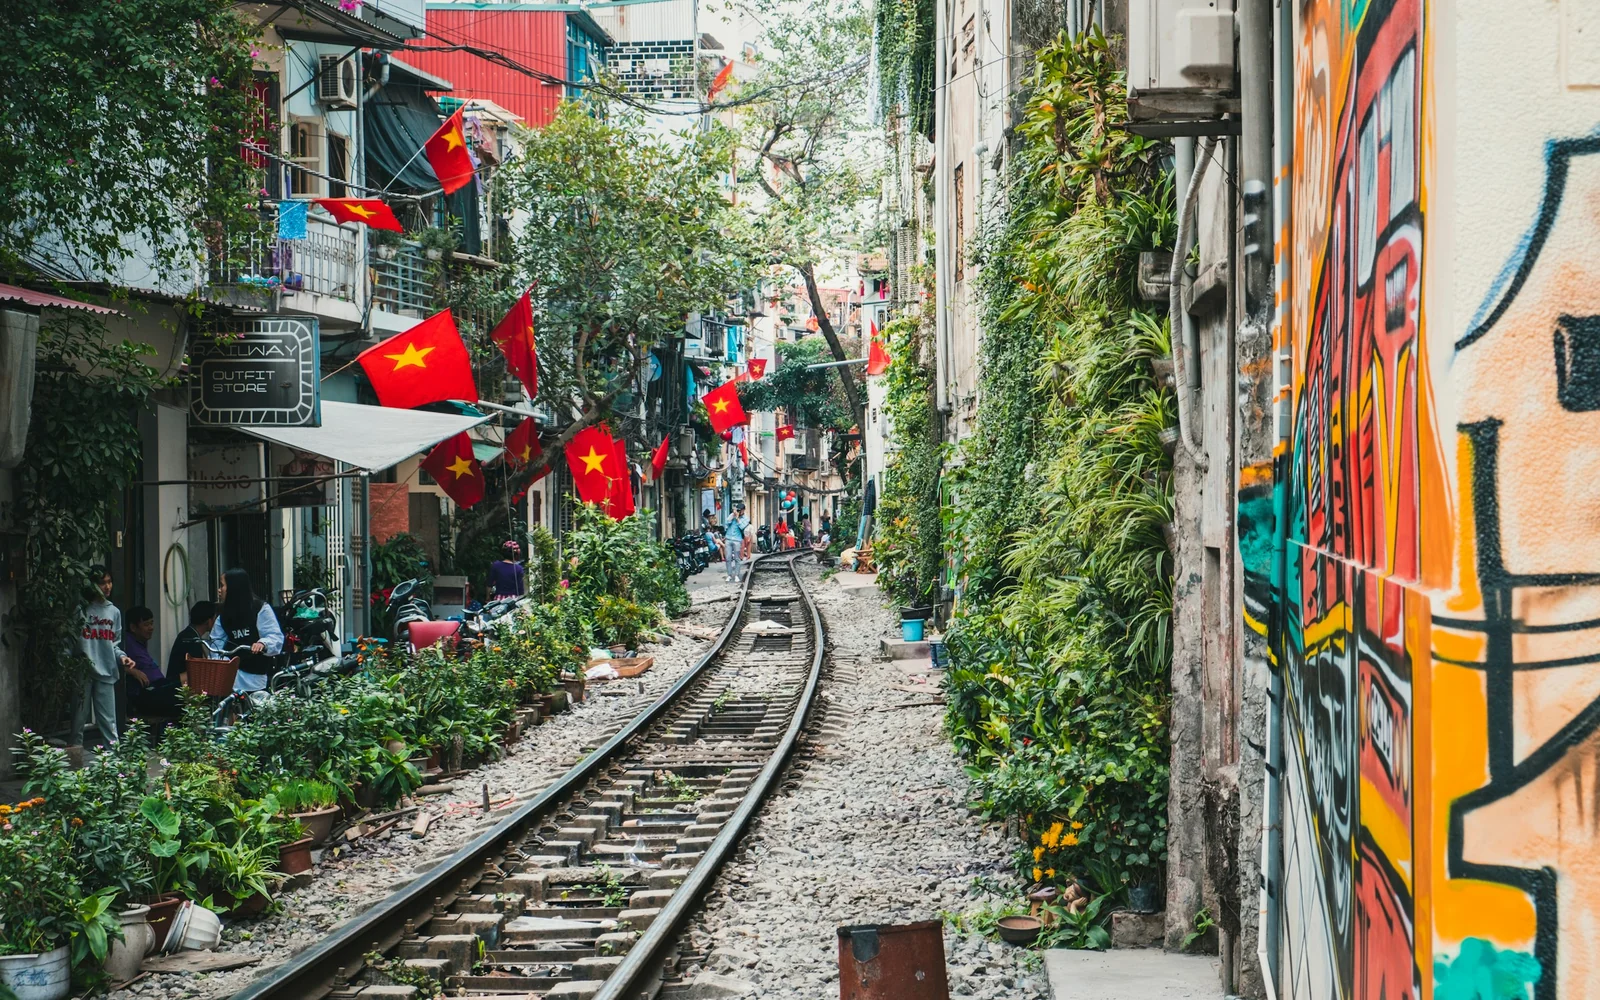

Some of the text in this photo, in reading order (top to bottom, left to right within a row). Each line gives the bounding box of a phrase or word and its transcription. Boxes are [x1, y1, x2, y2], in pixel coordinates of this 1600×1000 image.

[192, 344, 297, 356] RAILWAY
[212, 370, 275, 380] OUTFIT
[212, 383, 267, 393] STORE
